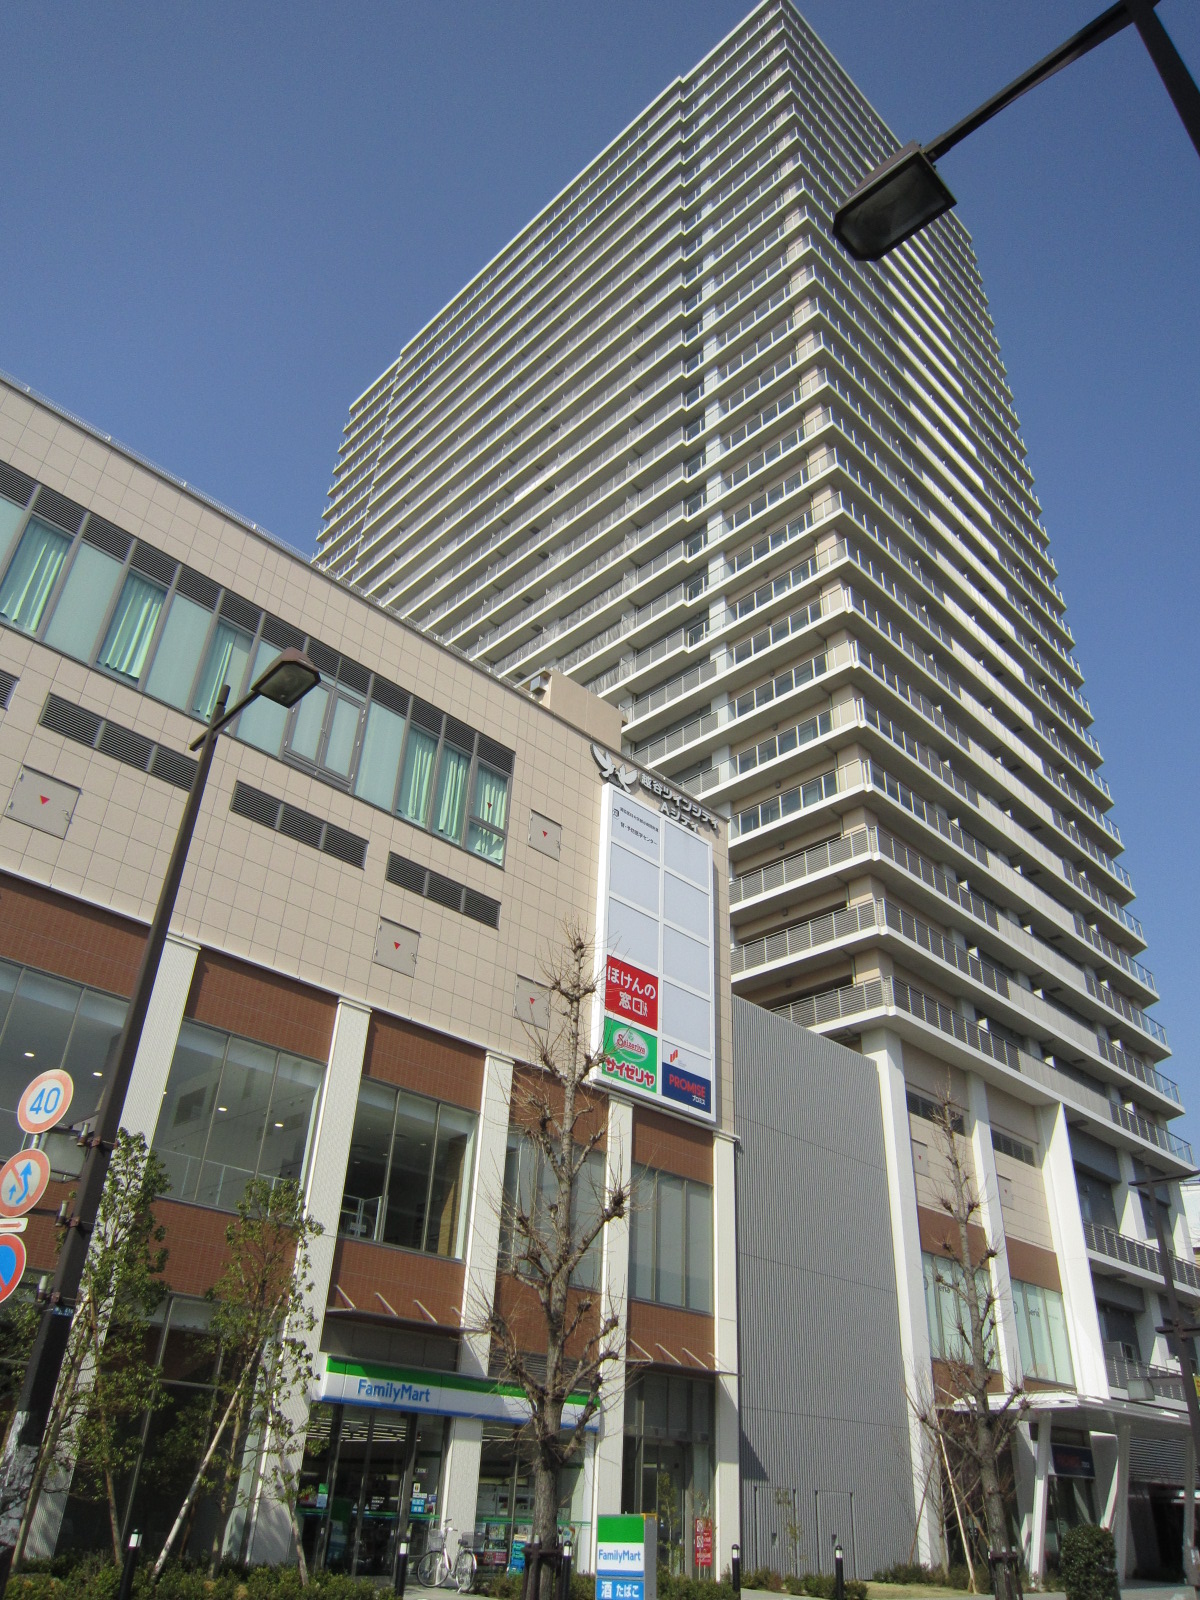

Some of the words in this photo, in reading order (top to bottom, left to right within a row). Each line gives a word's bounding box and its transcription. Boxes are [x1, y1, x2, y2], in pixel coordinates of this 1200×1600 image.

[640, 773, 719, 830] 越谷ツインシティ
[660, 802, 698, 832] Aシティ
[607, 965, 657, 1000] ほけんの
[618, 991, 643, 1015] 窓口
[605, 1056, 655, 1089] サイゼリヤ
[669, 1073, 706, 1098] PROMISE
[30, 1087, 61, 1115] 40
[692, 1095, 706, 1106] プロミス
[357, 1378, 431, 1403] FamilyMart
[598, 1549, 641, 1563] FamilyMart
[601, 1581, 613, 1599] 酒
[616, 1583, 640, 1598] たばこ
